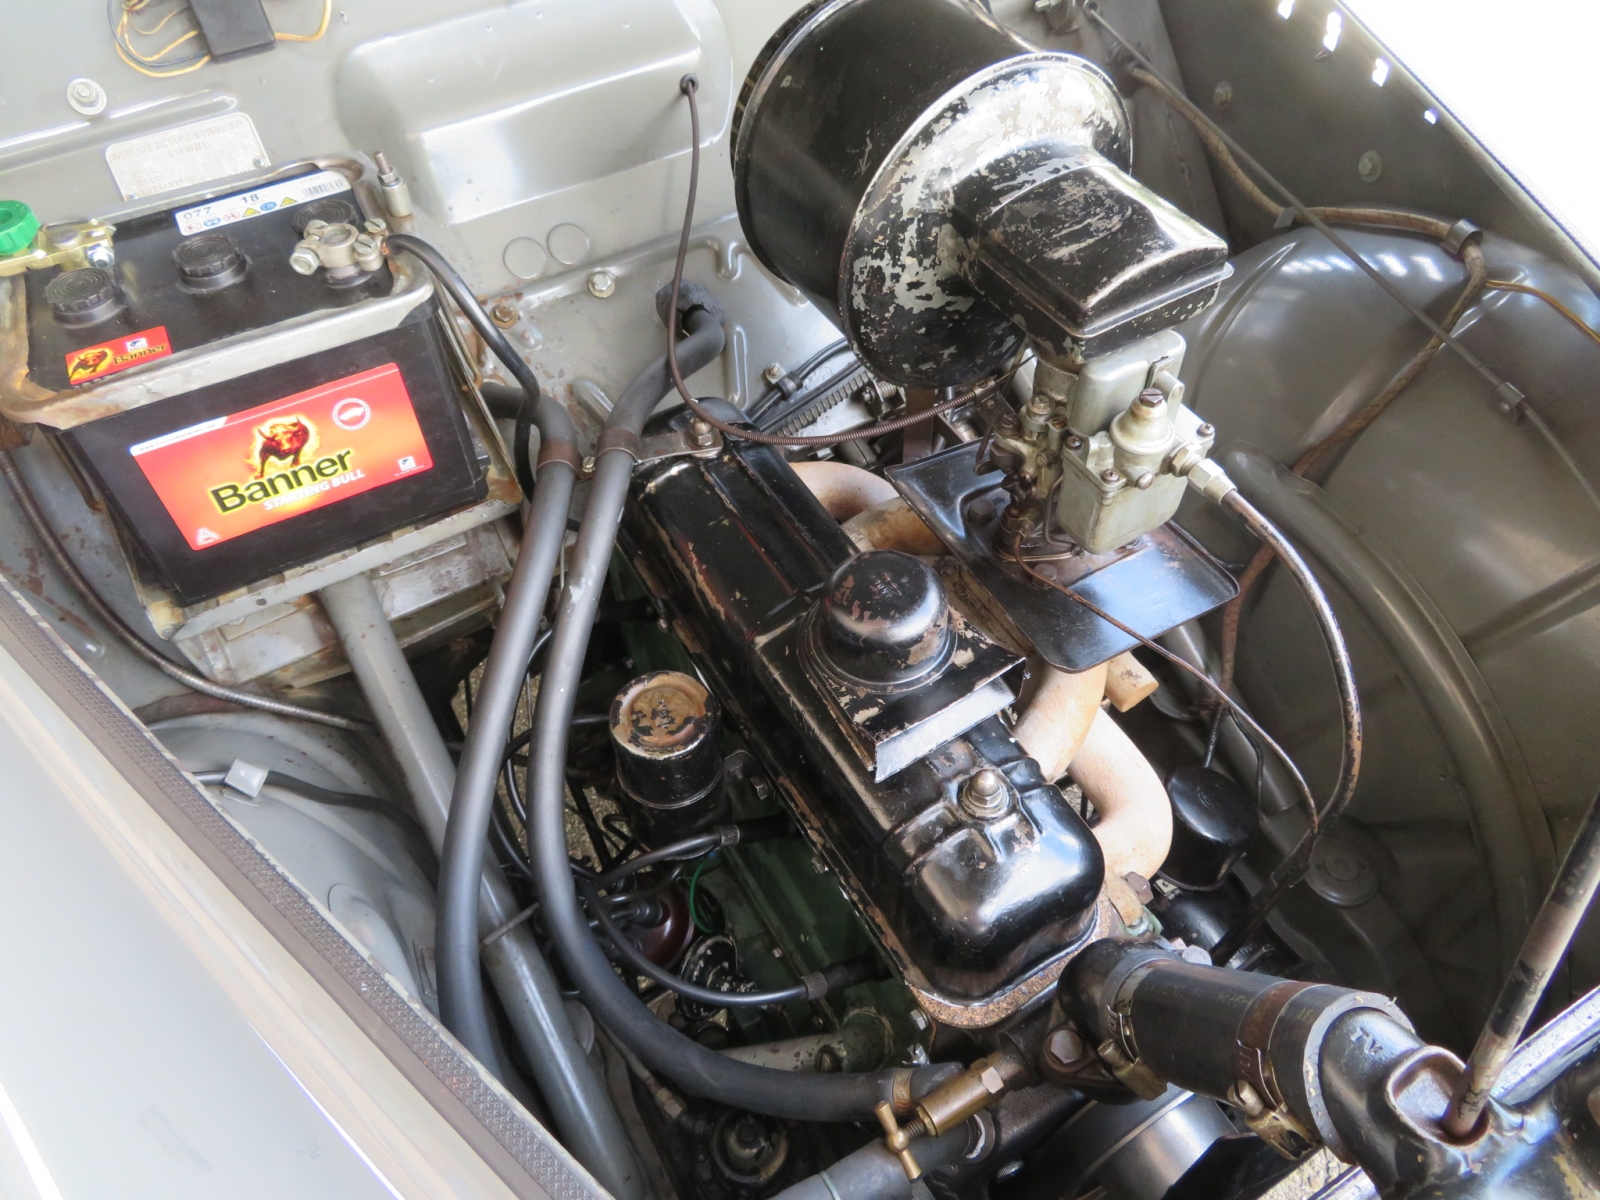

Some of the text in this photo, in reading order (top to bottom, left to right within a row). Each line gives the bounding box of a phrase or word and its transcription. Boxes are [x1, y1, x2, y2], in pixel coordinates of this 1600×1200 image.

[182, 206, 212, 221] 077
[241, 193, 259, 204] 18
[113, 344, 166, 365] Banner
[210, 449, 351, 514] Banner
[264, 481, 330, 511] STARTING
[331, 469, 365, 488] BULL
